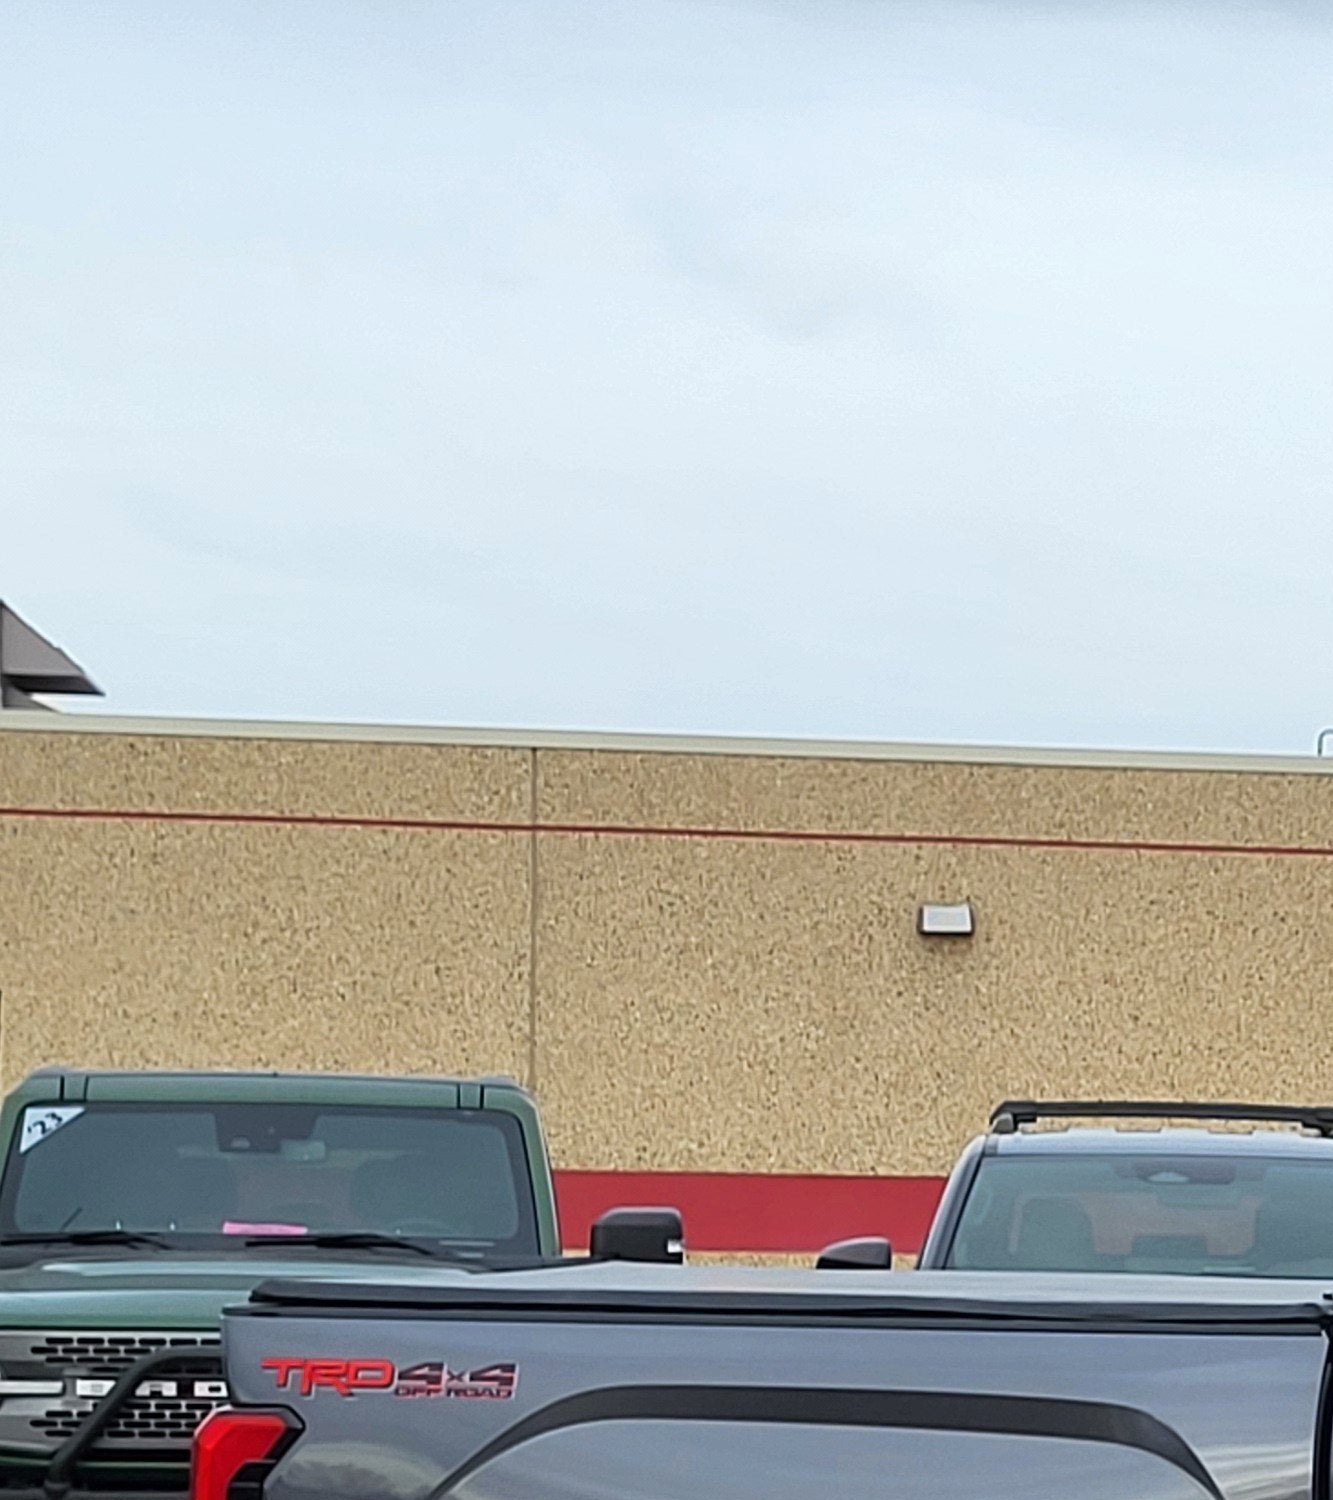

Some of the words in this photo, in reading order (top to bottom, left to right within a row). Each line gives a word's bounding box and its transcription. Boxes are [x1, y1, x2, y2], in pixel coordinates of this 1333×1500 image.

[260, 1357, 397, 1397] TRD
[394, 1386, 442, 1397] OFF
[446, 1387, 513, 1398] ROAD
